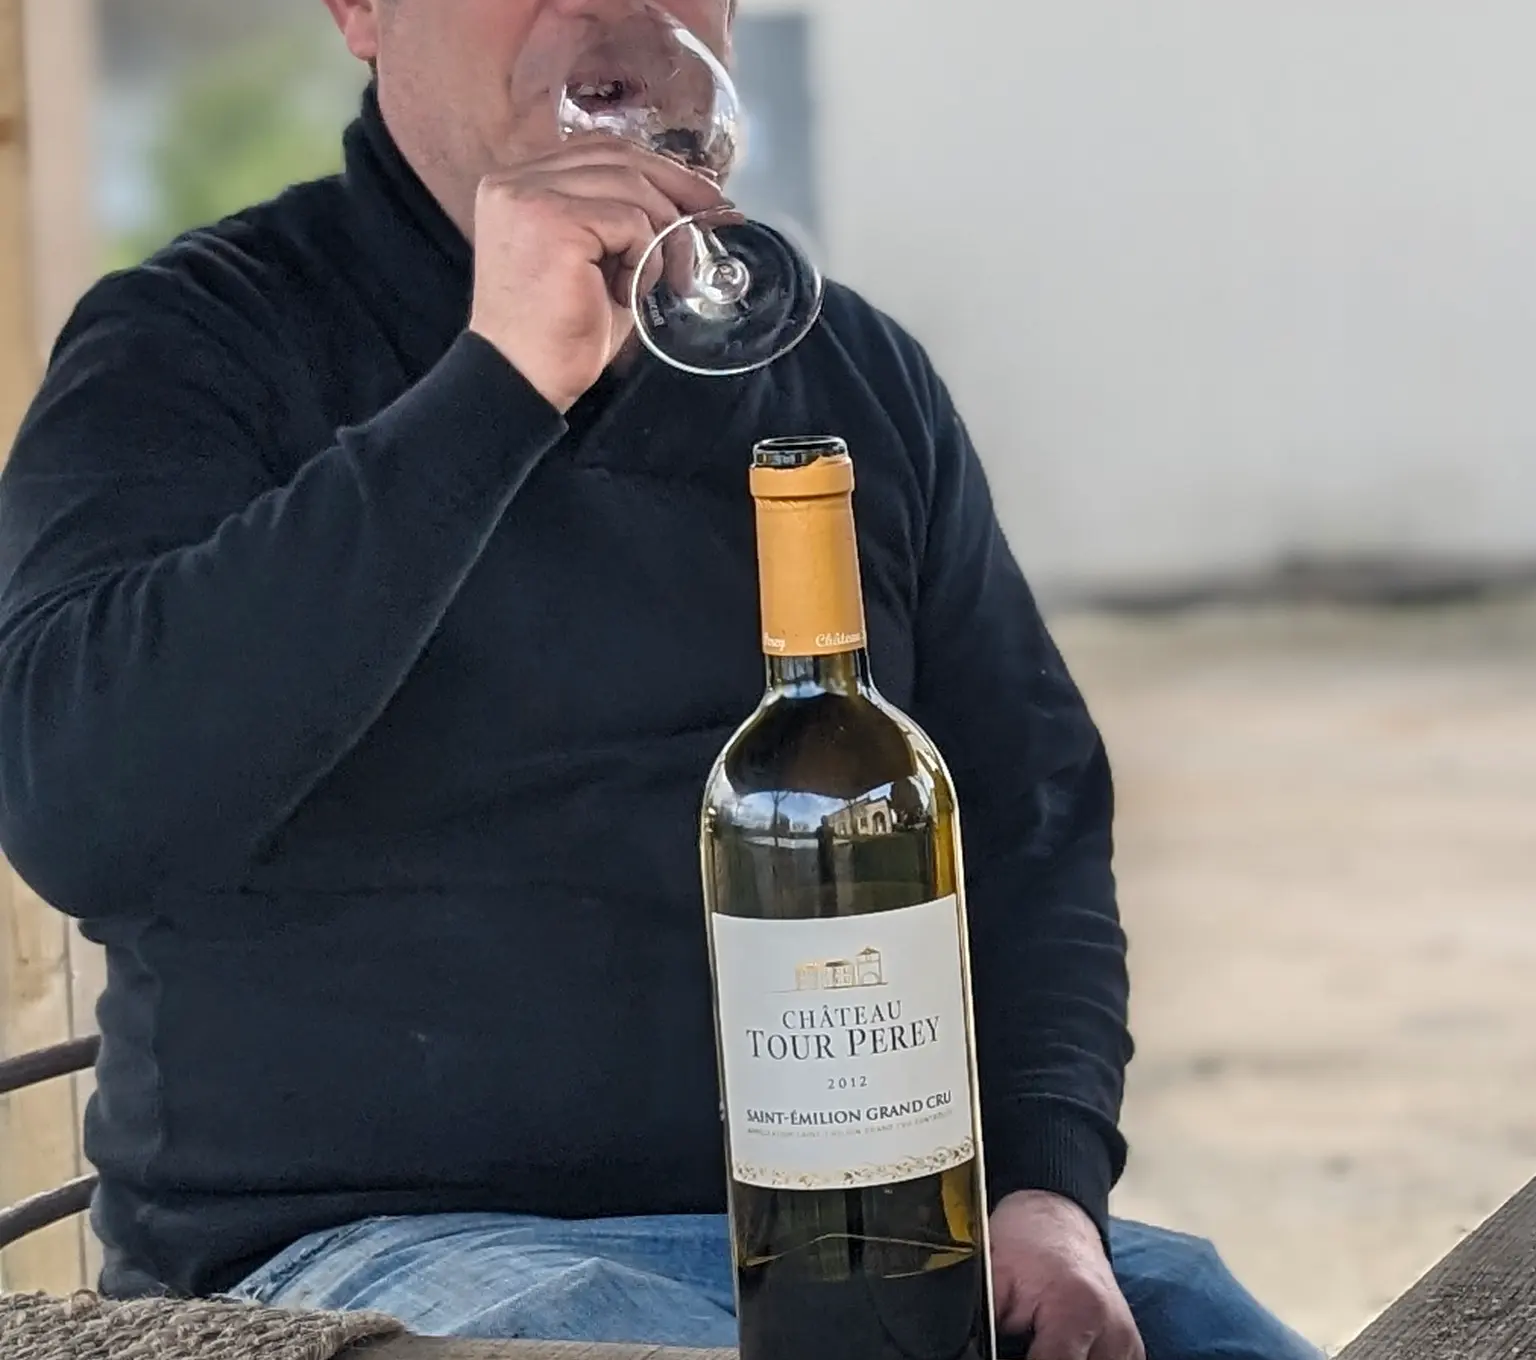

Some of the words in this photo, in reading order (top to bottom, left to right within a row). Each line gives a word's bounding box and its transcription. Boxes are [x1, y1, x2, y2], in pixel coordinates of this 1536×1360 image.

[782, 1000, 902, 1029] CHÂTEAU
[746, 1029, 835, 1060] TOUR
[845, 1016, 940, 1057] PEREY
[827, 1075, 868, 1090] 2012
[747, 1109, 861, 1126] SAINT-ÉMILION
[866, 1099, 924, 1122] GRAND
[926, 1089, 952, 1109] CRU
